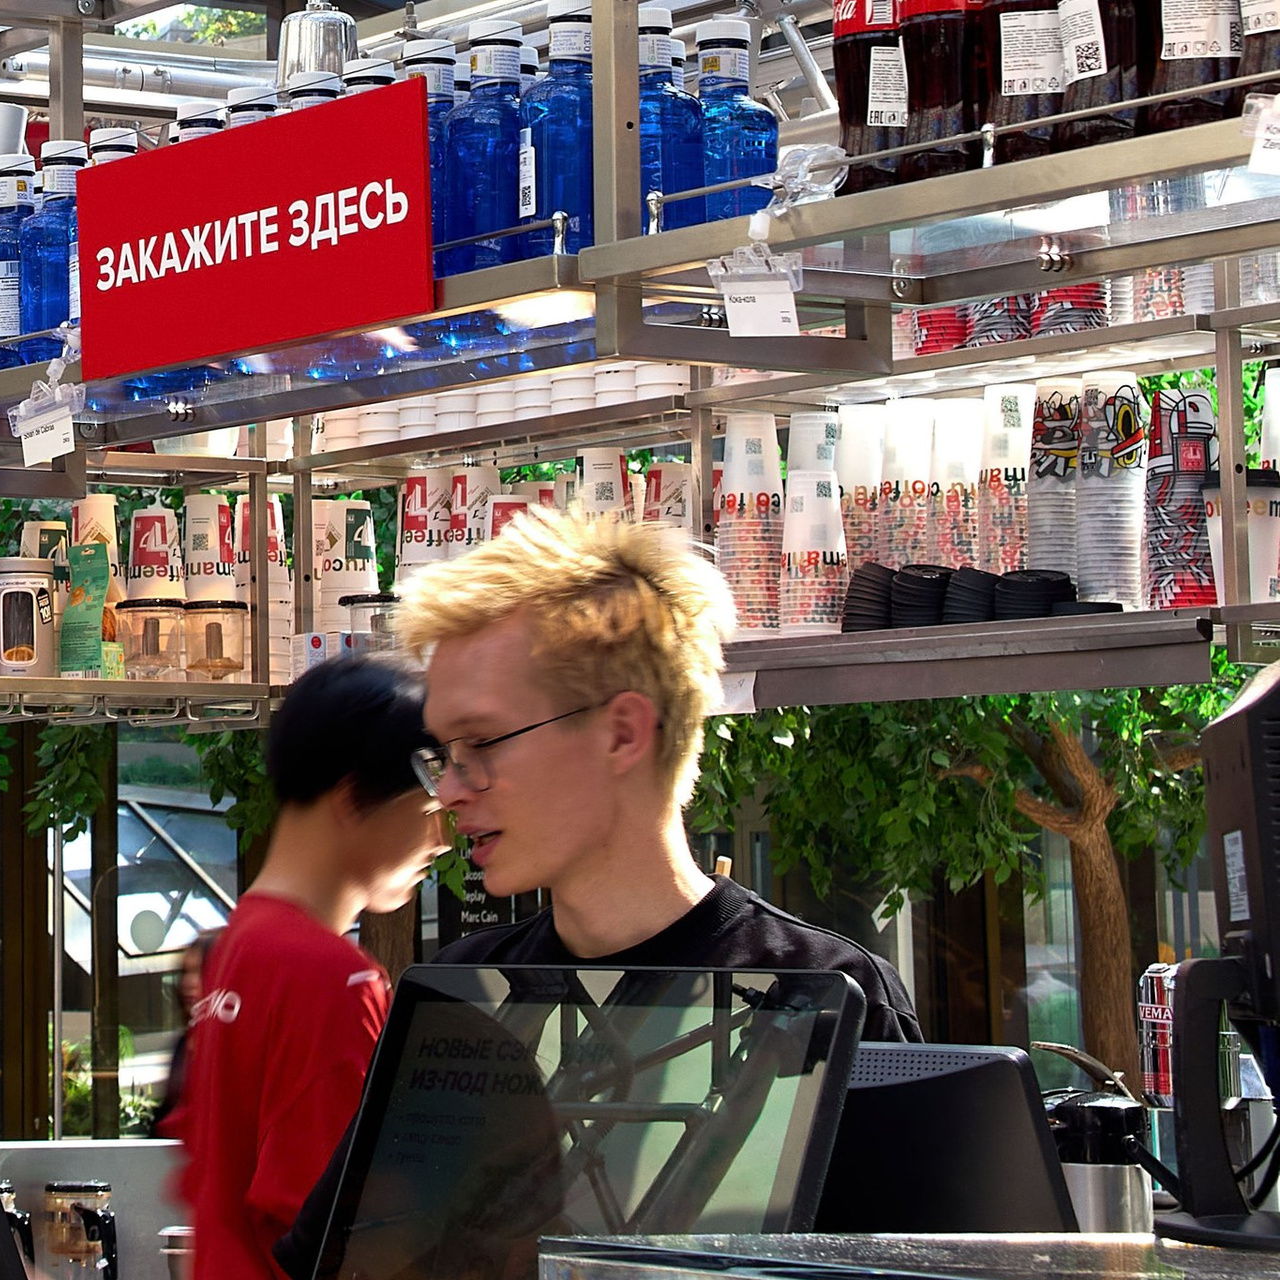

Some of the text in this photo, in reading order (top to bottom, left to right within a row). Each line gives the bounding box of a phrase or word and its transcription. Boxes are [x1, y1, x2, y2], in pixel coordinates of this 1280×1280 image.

[96, 206, 279, 291] ЗАКАЖИТЕ
[288, 178, 409, 251] ЗДЕСЬ
[461, 910, 498, 923] Marc Cain
[418, 1037, 494, 1060] НОВЫЕ
